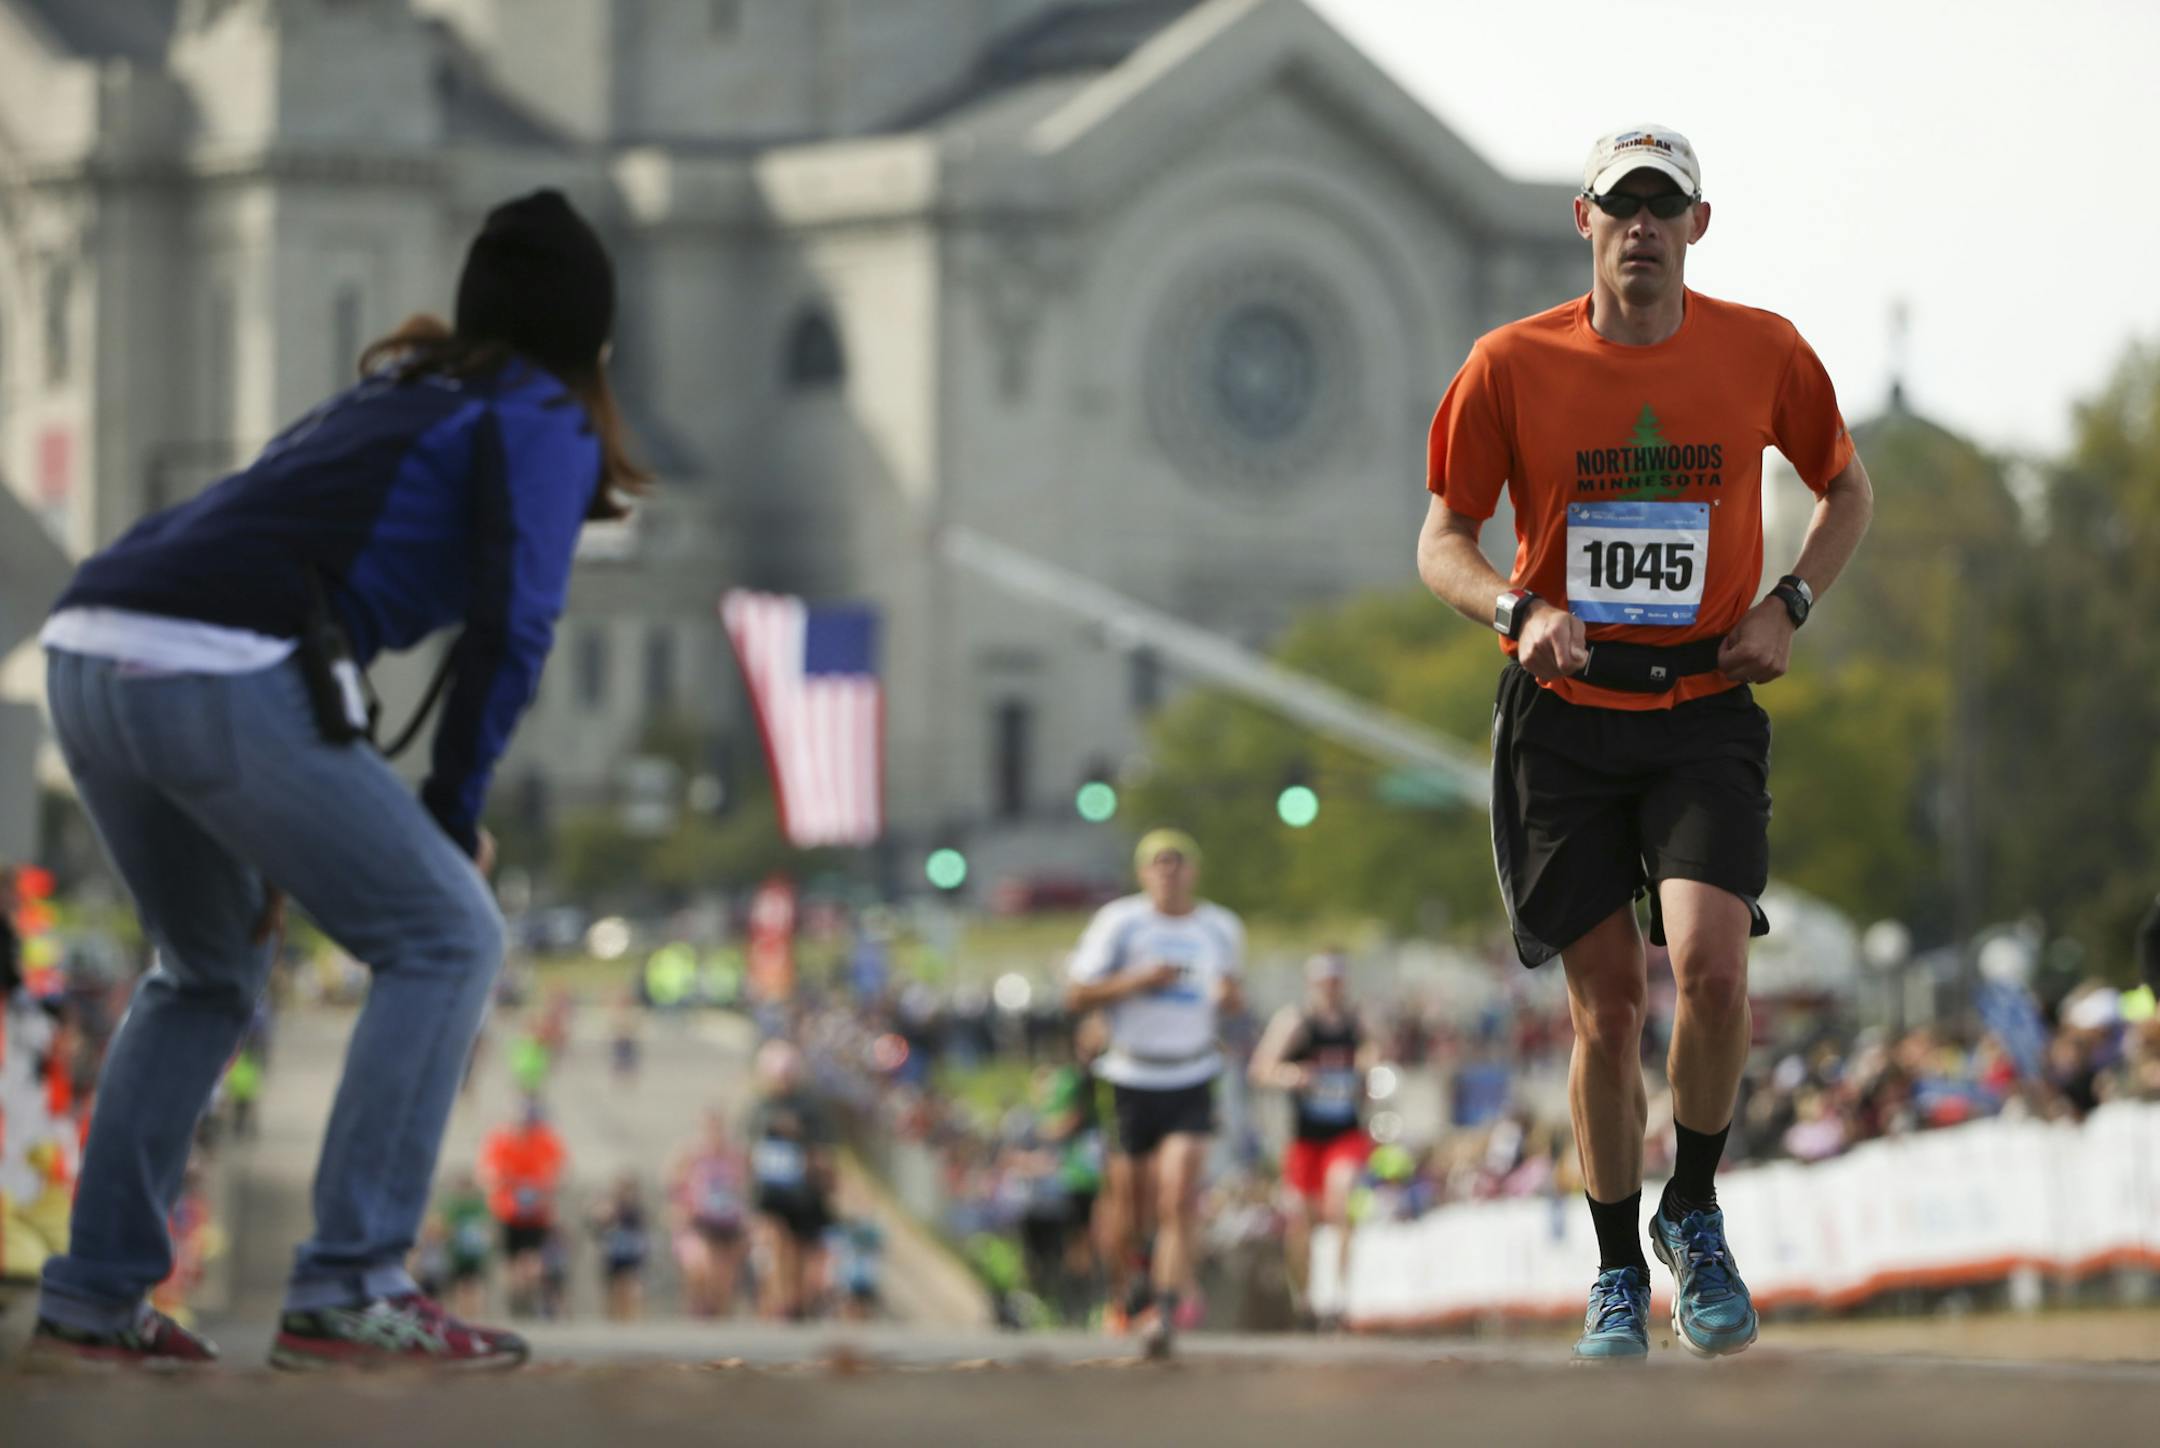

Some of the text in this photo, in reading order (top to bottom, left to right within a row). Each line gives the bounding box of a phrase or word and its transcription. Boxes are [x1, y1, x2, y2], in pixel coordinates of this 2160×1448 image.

[1576, 444, 1722, 476] NORTHWOODS
[1577, 474, 1722, 491] MINNESOTA
[1583, 540, 1694, 592] 1045
